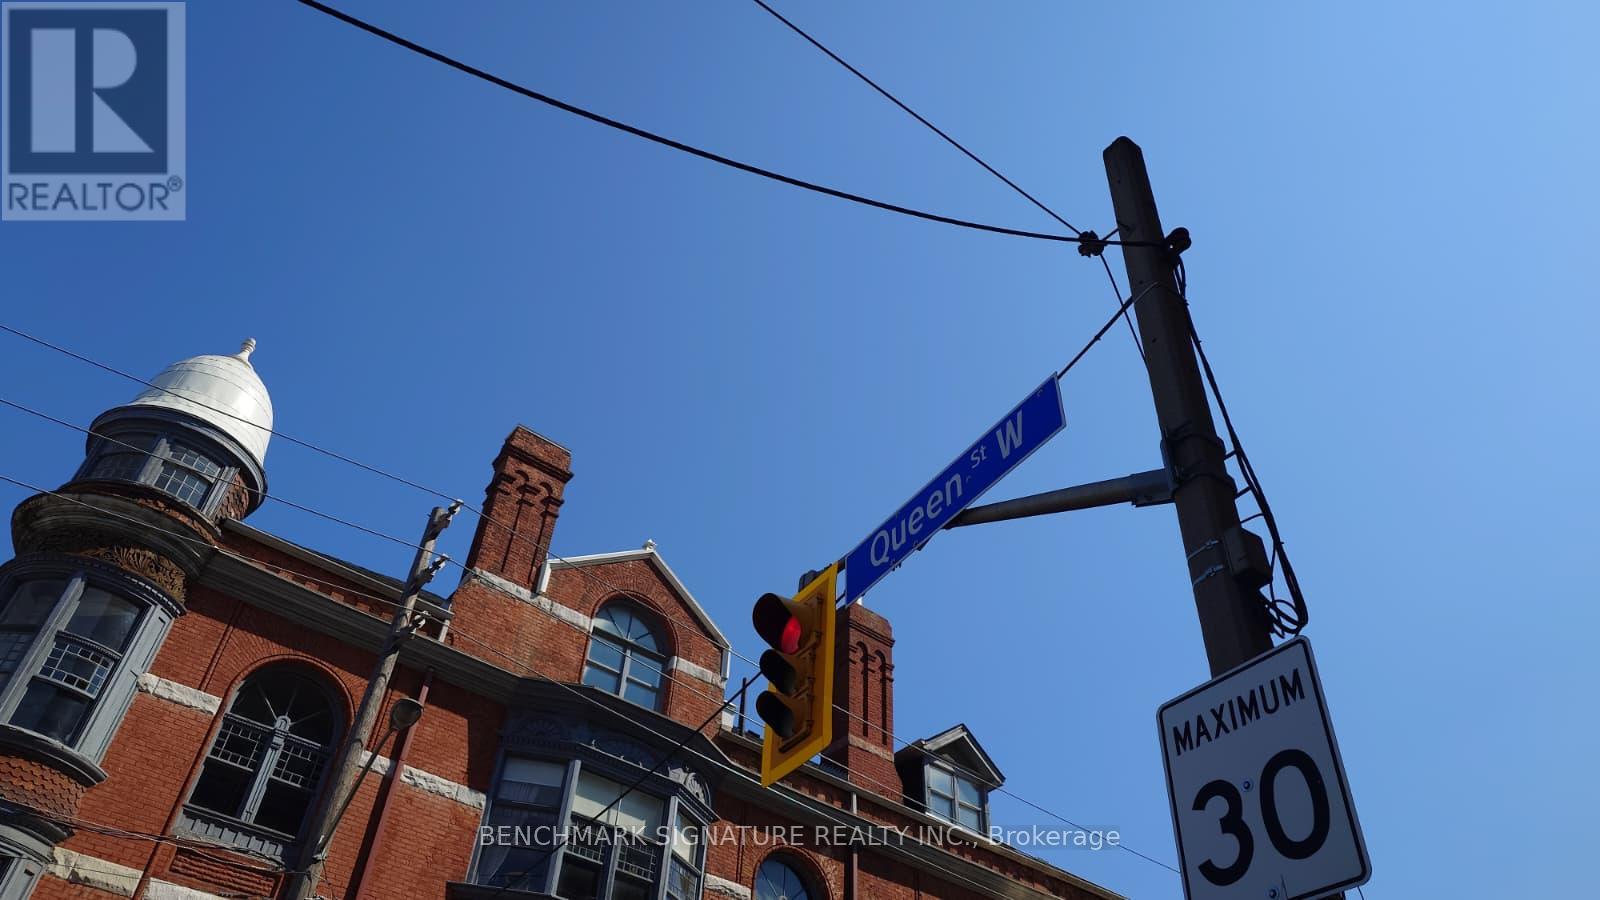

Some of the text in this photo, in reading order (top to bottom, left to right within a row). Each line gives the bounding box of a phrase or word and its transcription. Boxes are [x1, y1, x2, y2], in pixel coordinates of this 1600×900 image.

[870, 409, 1024, 567] Queen St W
[1172, 667, 1306, 757] MAXIMUM
[1191, 748, 1331, 887] 30
